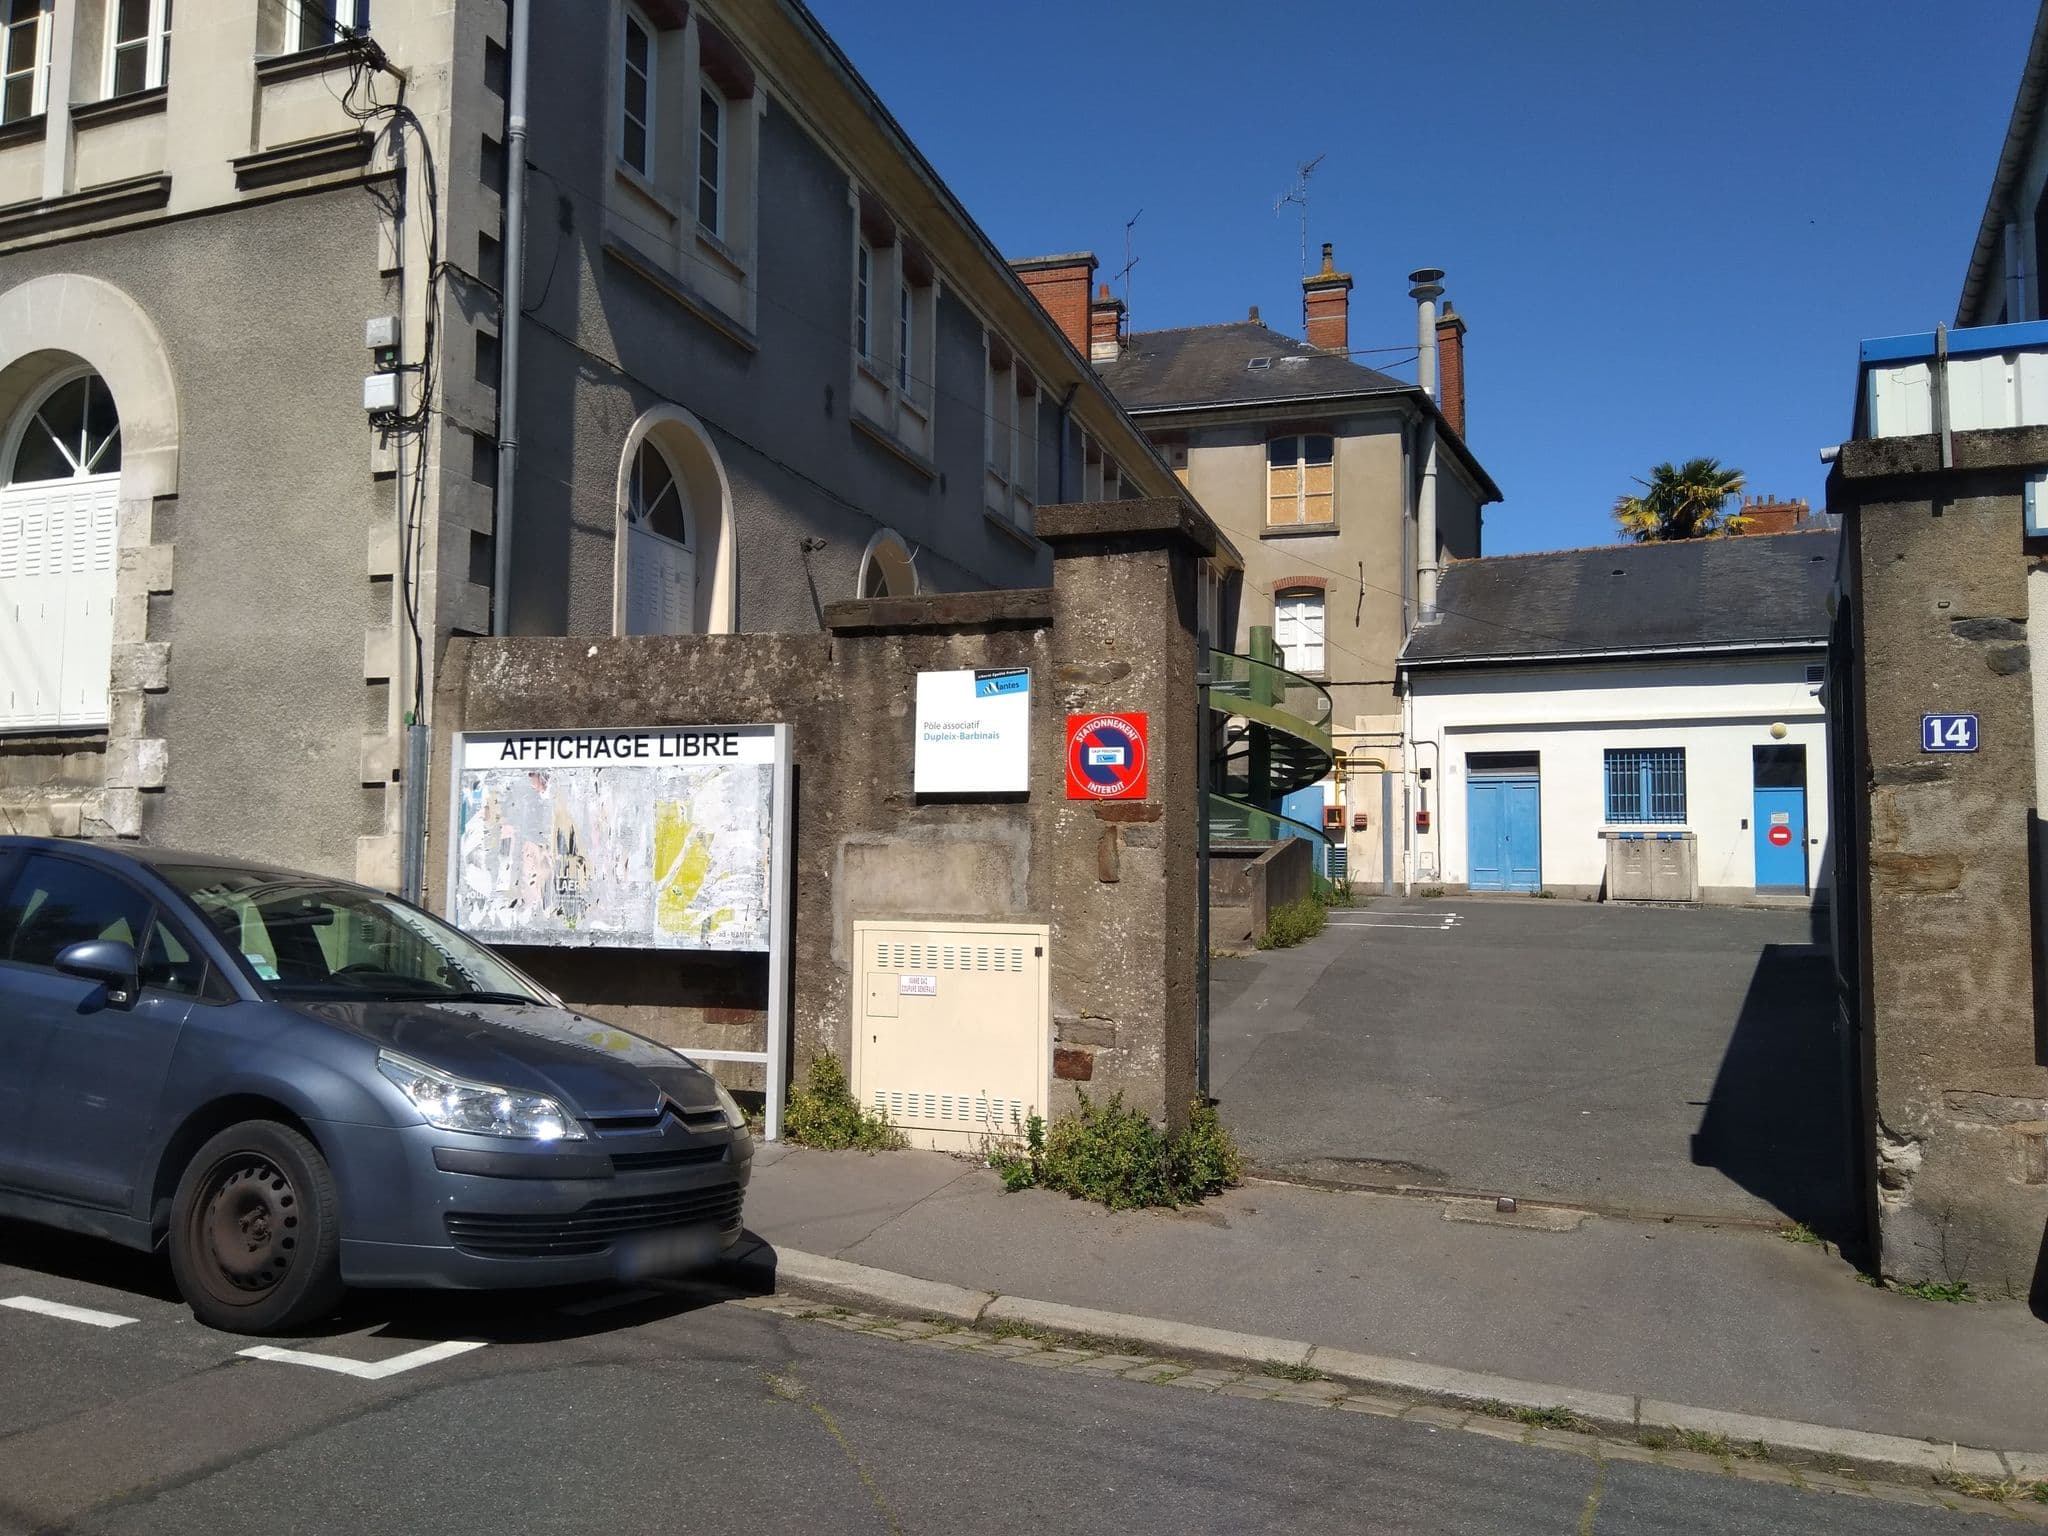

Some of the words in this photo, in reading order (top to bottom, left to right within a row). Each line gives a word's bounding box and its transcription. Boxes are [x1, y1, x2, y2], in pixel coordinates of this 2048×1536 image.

[923, 722, 941, 730] Pôle
[942, 720, 980, 730] associatif
[1076, 718, 1139, 743] STATIONNEMENT
[1930, 719, 1970, 746] 14
[923, 730, 1000, 742] Dupleix-Barbinais
[500, 735, 650, 760] AFFICHAGE
[659, 732, 739, 757] LIBRE
[1087, 781, 1125, 794] INTERDIT
